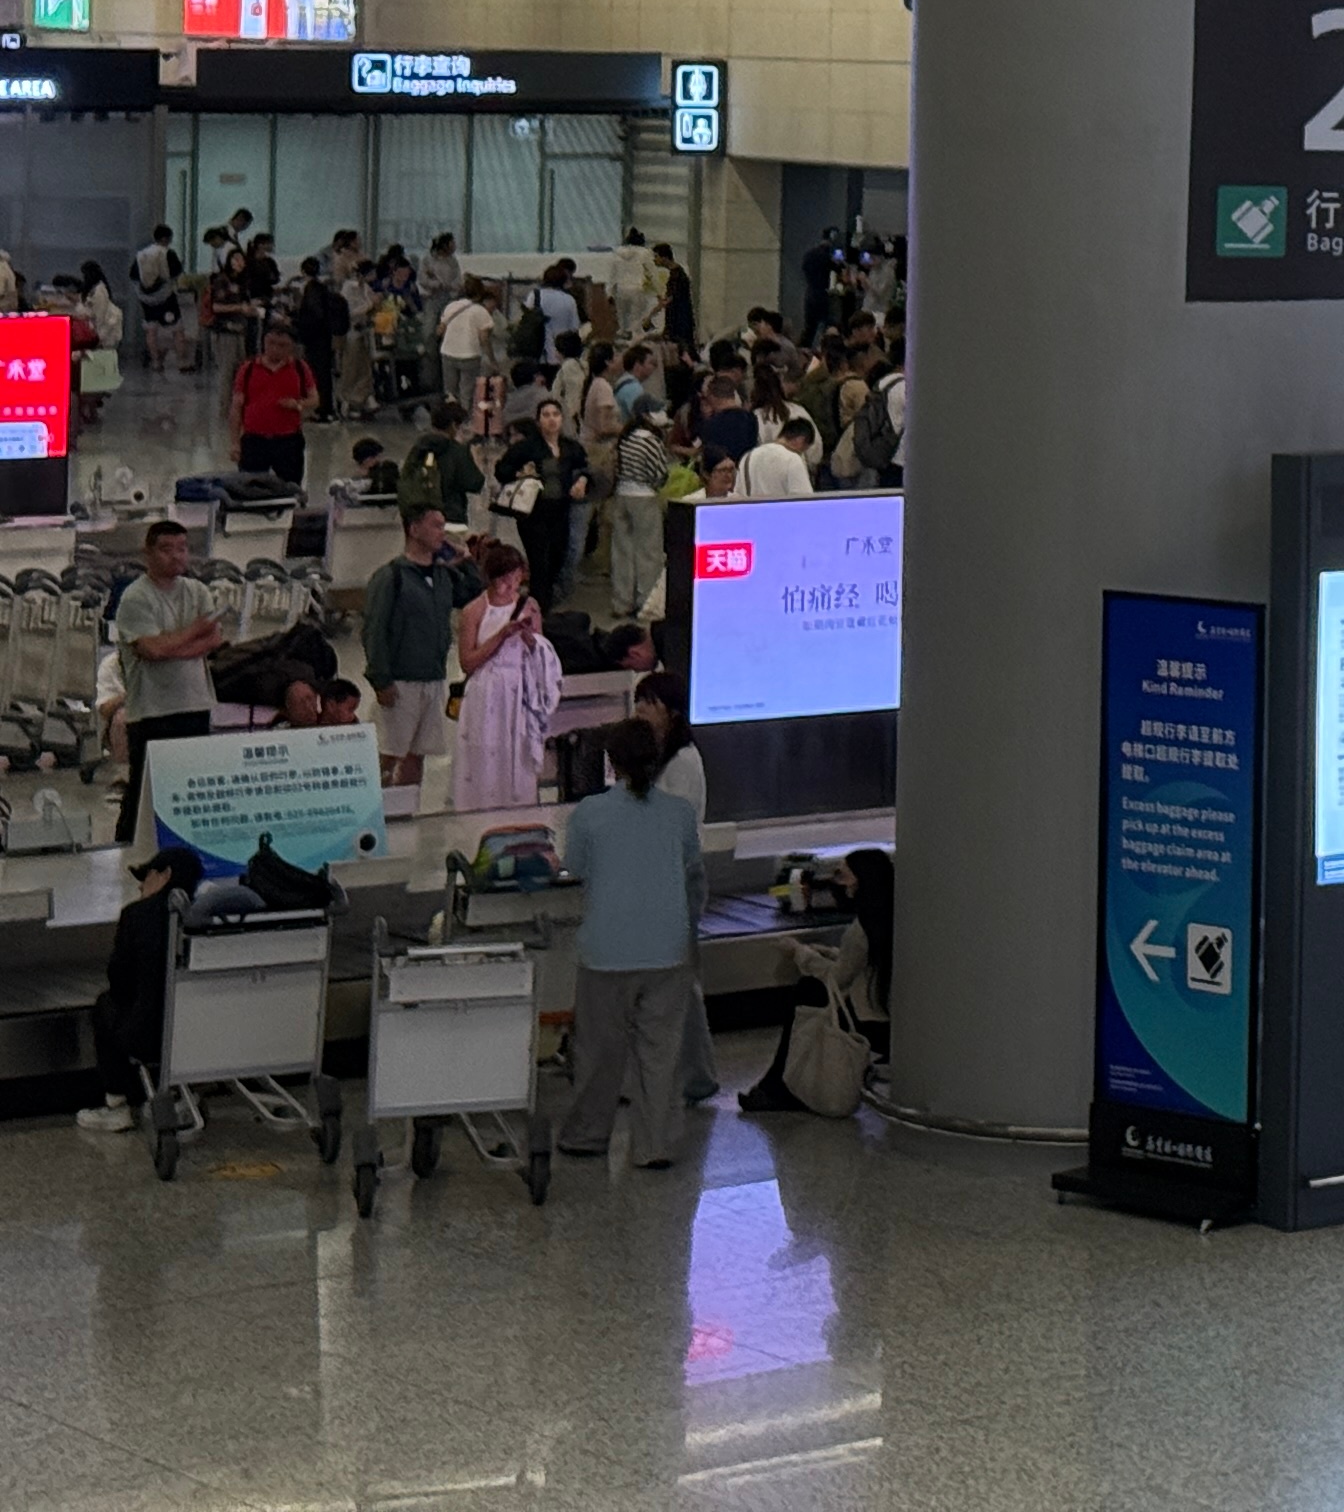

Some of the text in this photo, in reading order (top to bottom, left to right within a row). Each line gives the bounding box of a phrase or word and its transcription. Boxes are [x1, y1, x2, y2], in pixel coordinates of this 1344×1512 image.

[394, 55, 471, 78] 行李查询
[10, 78, 56, 99] AREA
[392, 76, 517, 96] Baggage Inquiries
[706, 549, 747, 572] 天猫
[781, 583, 860, 614] 怕痛经
[1142, 680, 1224, 701] Kind Reminder
[1122, 796, 1236, 824] Excess baggage please
[1122, 819, 1225, 843] pick up at the excess
[1122, 837, 1232, 864] baggage claim area at
[1121, 857, 1139, 871] the
[1140, 860, 1183, 877] elevator
